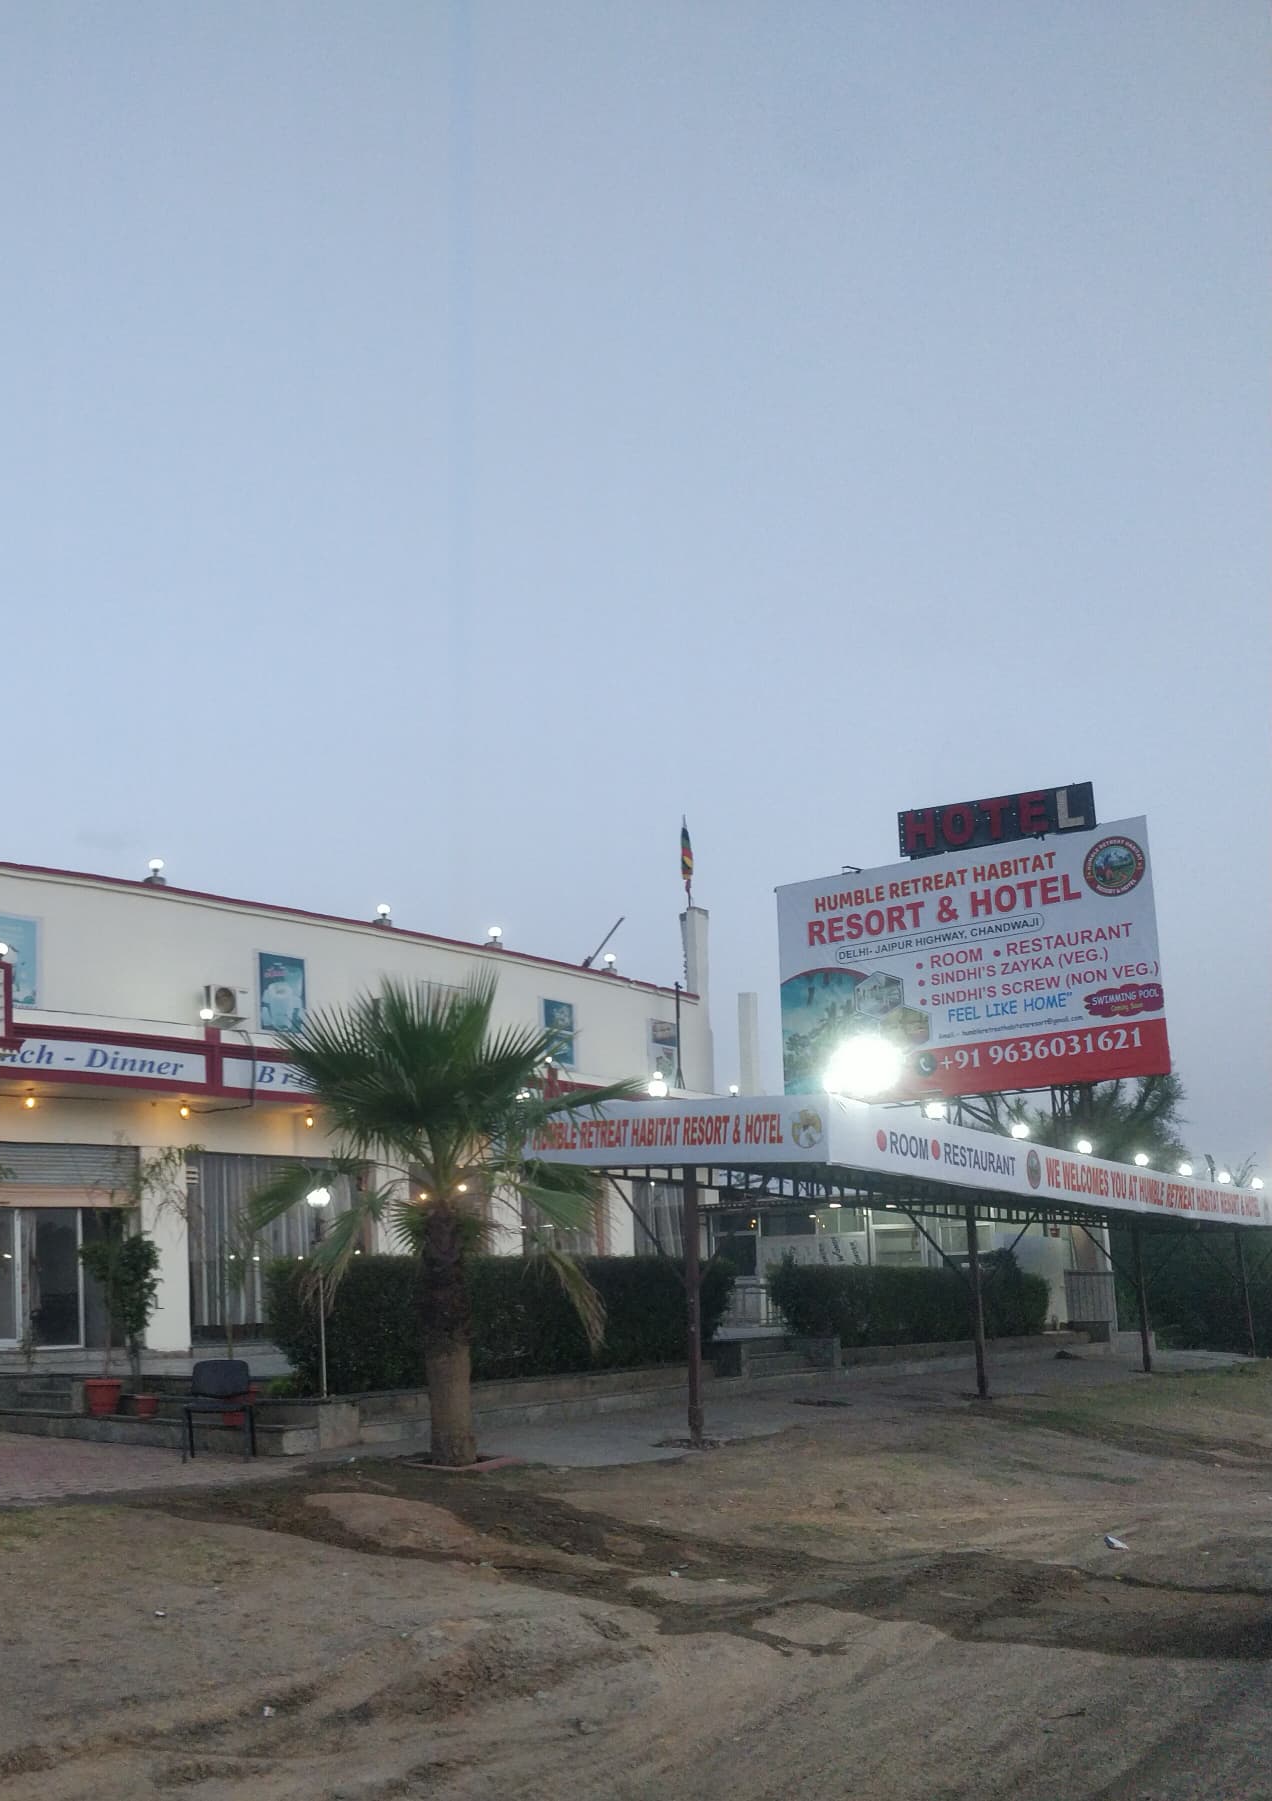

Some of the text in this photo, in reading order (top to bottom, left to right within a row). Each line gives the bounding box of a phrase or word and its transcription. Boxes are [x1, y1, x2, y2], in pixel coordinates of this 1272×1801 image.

[905, 788, 1085, 852] HOTEL
[814, 851, 1056, 914] HUMBLE RETREAT HABITAT
[807, 874, 1082, 946] RESORT & HOTEL
[875, 940, 912, 955] JAIPUR
[915, 930, 968, 948] HIGHWAY,
[970, 917, 1040, 937] CHANDWAJI
[930, 922, 1133, 969] ROOM RESTAURANT
[1001, 956, 1054, 976] ZAYKA
[1058, 947, 1109, 971] (VEG.)
[1002, 976, 1061, 996] SCREW
[1065, 969, 1107, 990] (NON
[1111, 960, 1159, 979] VEG.)
[948, 1006, 980, 1023] FEEL
[985, 1001, 1017, 1018] LIKE
[1091, 988, 1159, 1006] SWIMMING POOL
[84, 1048, 184, 1077] Dinner
[940, 1027, 1142, 1070] +91 9636031621
[580, 1118, 629, 1149] RETREAT
[631, 1117, 680, 1147] HABITAT
[683, 1115, 730, 1145] RESORT
[732, 1114, 740, 1144] &
[744, 1113, 783, 1144] HOTEL
[890, 1131, 929, 1160] ROOM
[943, 1143, 1015, 1176] RESTAURANT
[1045, 1157, 1060, 1189] WE
[1062, 1161, 1109, 1197] WELCOMES
[1111, 1170, 1127, 1198] YOU
[1128, 1175, 1138, 1201] AT
[1139, 1176, 1164, 1206] HUMBLE
[1166, 1183, 1194, 1210] RETREAT
